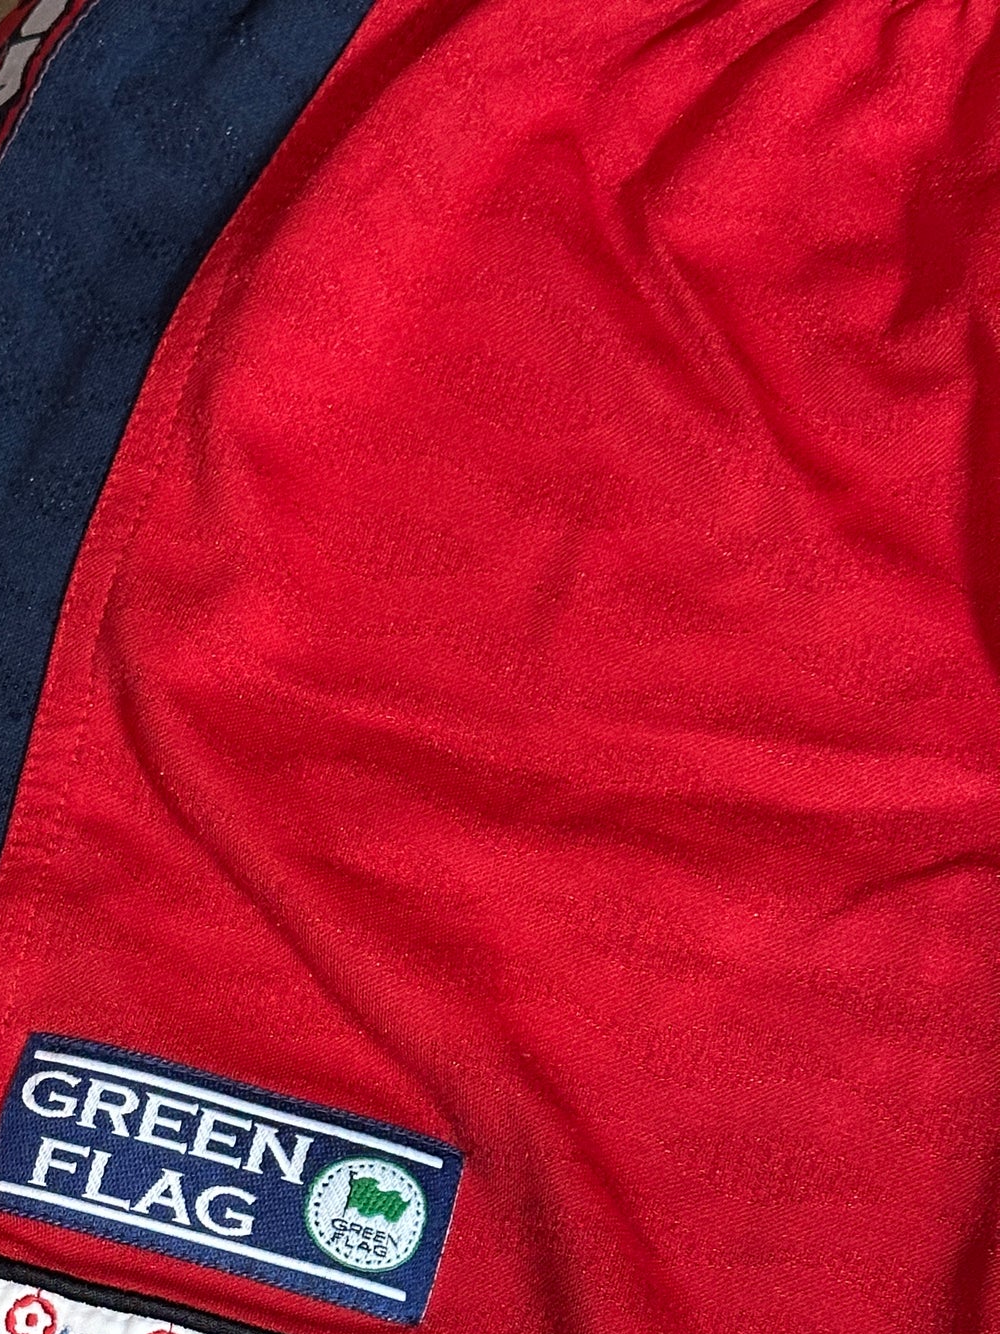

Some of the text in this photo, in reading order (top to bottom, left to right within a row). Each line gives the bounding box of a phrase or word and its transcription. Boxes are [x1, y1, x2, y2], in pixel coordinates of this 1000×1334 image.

[22, 1070, 315, 1186] GREEN
[26, 1136, 256, 1239] FLAG
[331, 1218, 400, 1251] GREEN
[331, 1231, 388, 1258] FLAG
